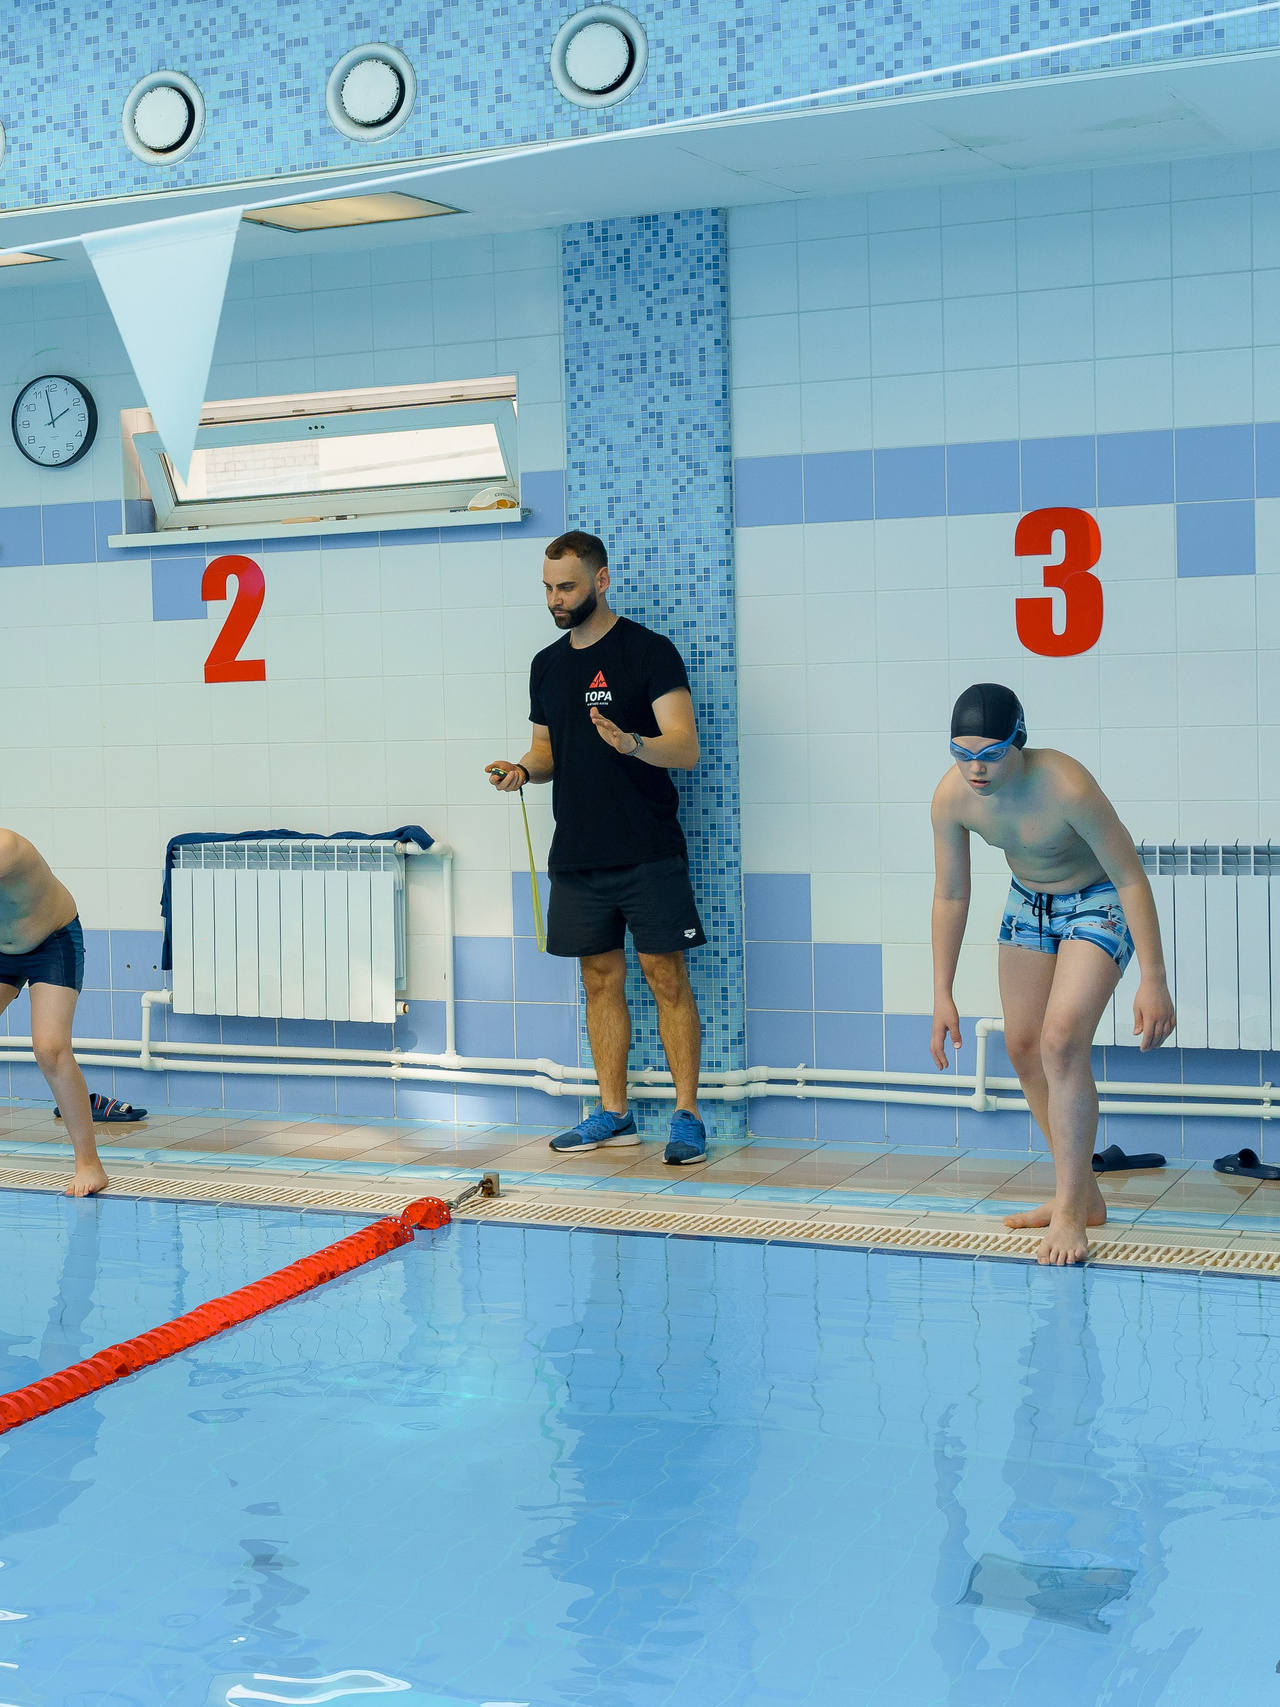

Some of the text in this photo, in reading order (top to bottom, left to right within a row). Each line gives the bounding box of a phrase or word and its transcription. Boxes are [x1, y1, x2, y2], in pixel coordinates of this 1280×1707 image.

[45, 383, 58, 393] 12
[63, 387, 68, 396] 1
[33, 390, 42, 399] 11
[72, 397, 81, 407] 2
[24, 403, 37, 412] 10
[77, 413, 86, 422] 3
[22, 420, 31, 429] 9
[75, 429, 83, 438] 4
[27, 435, 36, 444] 8
[38, 446, 46, 455] 7
[66, 442, 75, 451] 5
[52, 450, 60, 459] 6
[1015, 507, 1104, 658] 3
[201, 554, 266, 684] 2
[585, 691, 613, 703] ГОРА
